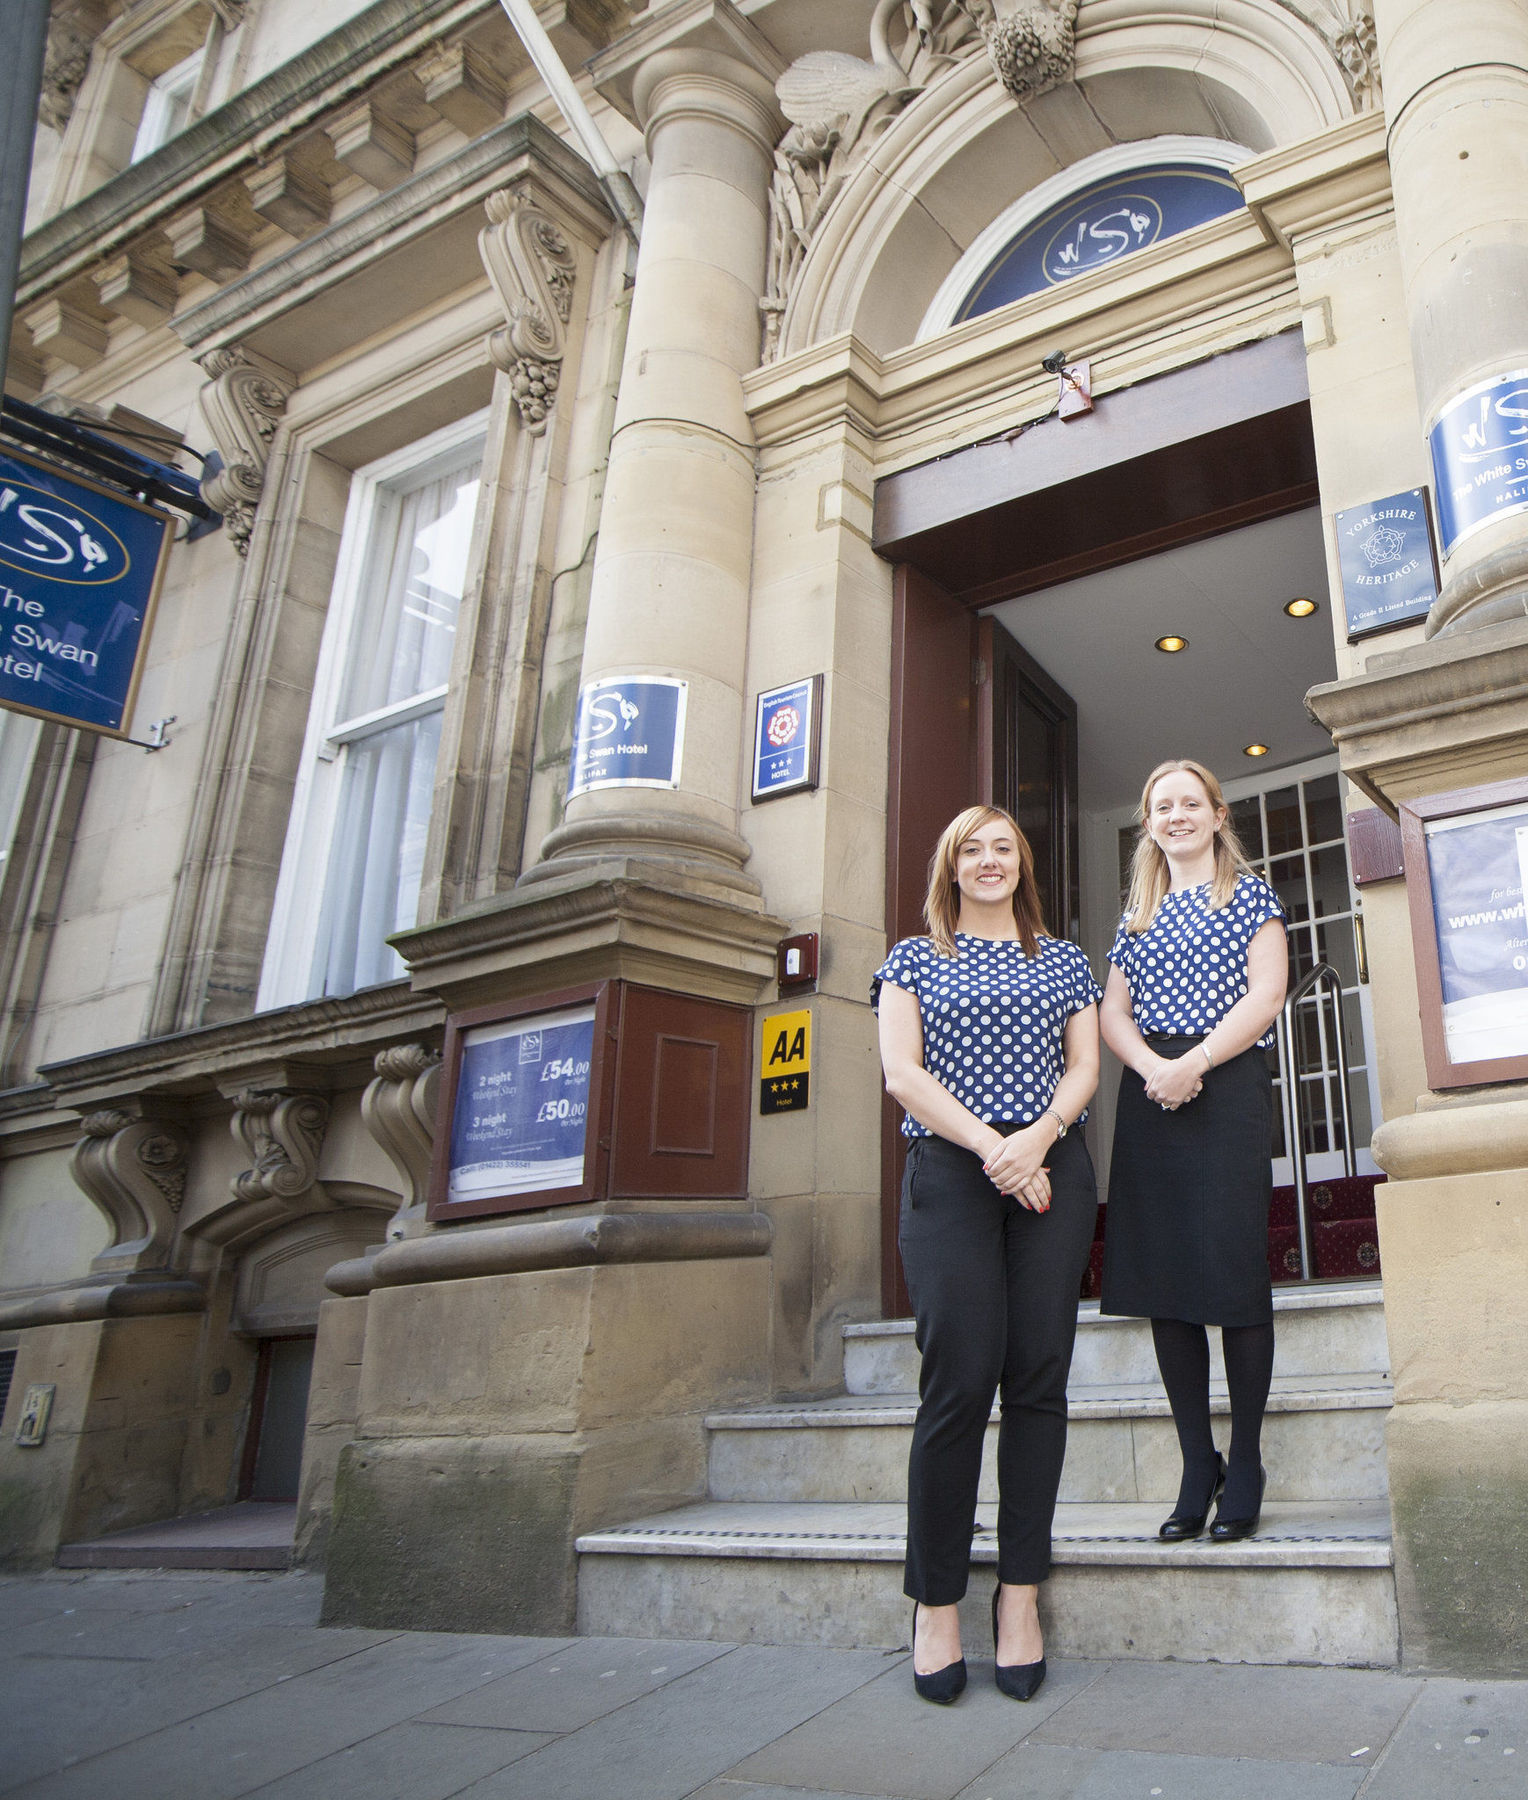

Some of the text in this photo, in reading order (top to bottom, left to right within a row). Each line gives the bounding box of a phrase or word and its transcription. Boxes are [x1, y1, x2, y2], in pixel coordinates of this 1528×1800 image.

[1474, 464, 1512, 488] White
[1515, 457, 1528, 471] S
[1346, 508, 1417, 538] YORKSHIRE
[1355, 559, 1420, 586] HERITAGE
[1359, 609, 1377, 619] Grade
[1385, 601, 1404, 612] Listed
[1406, 595, 1432, 607] Building
[11, 624, 99, 668] Swan
[0, 654, 43, 682] tel
[589, 747, 615, 759] Swan
[616, 743, 648, 755] Hotel
[771, 768, 791, 780] HOTEL
[1488, 888, 1504, 904] for
[769, 1027, 805, 1065] AA
[480, 1057, 589, 1087] 2 night £54.00
[473, 1098, 585, 1128] 3 night £50.00
[776, 1097, 793, 1107] Hotel
